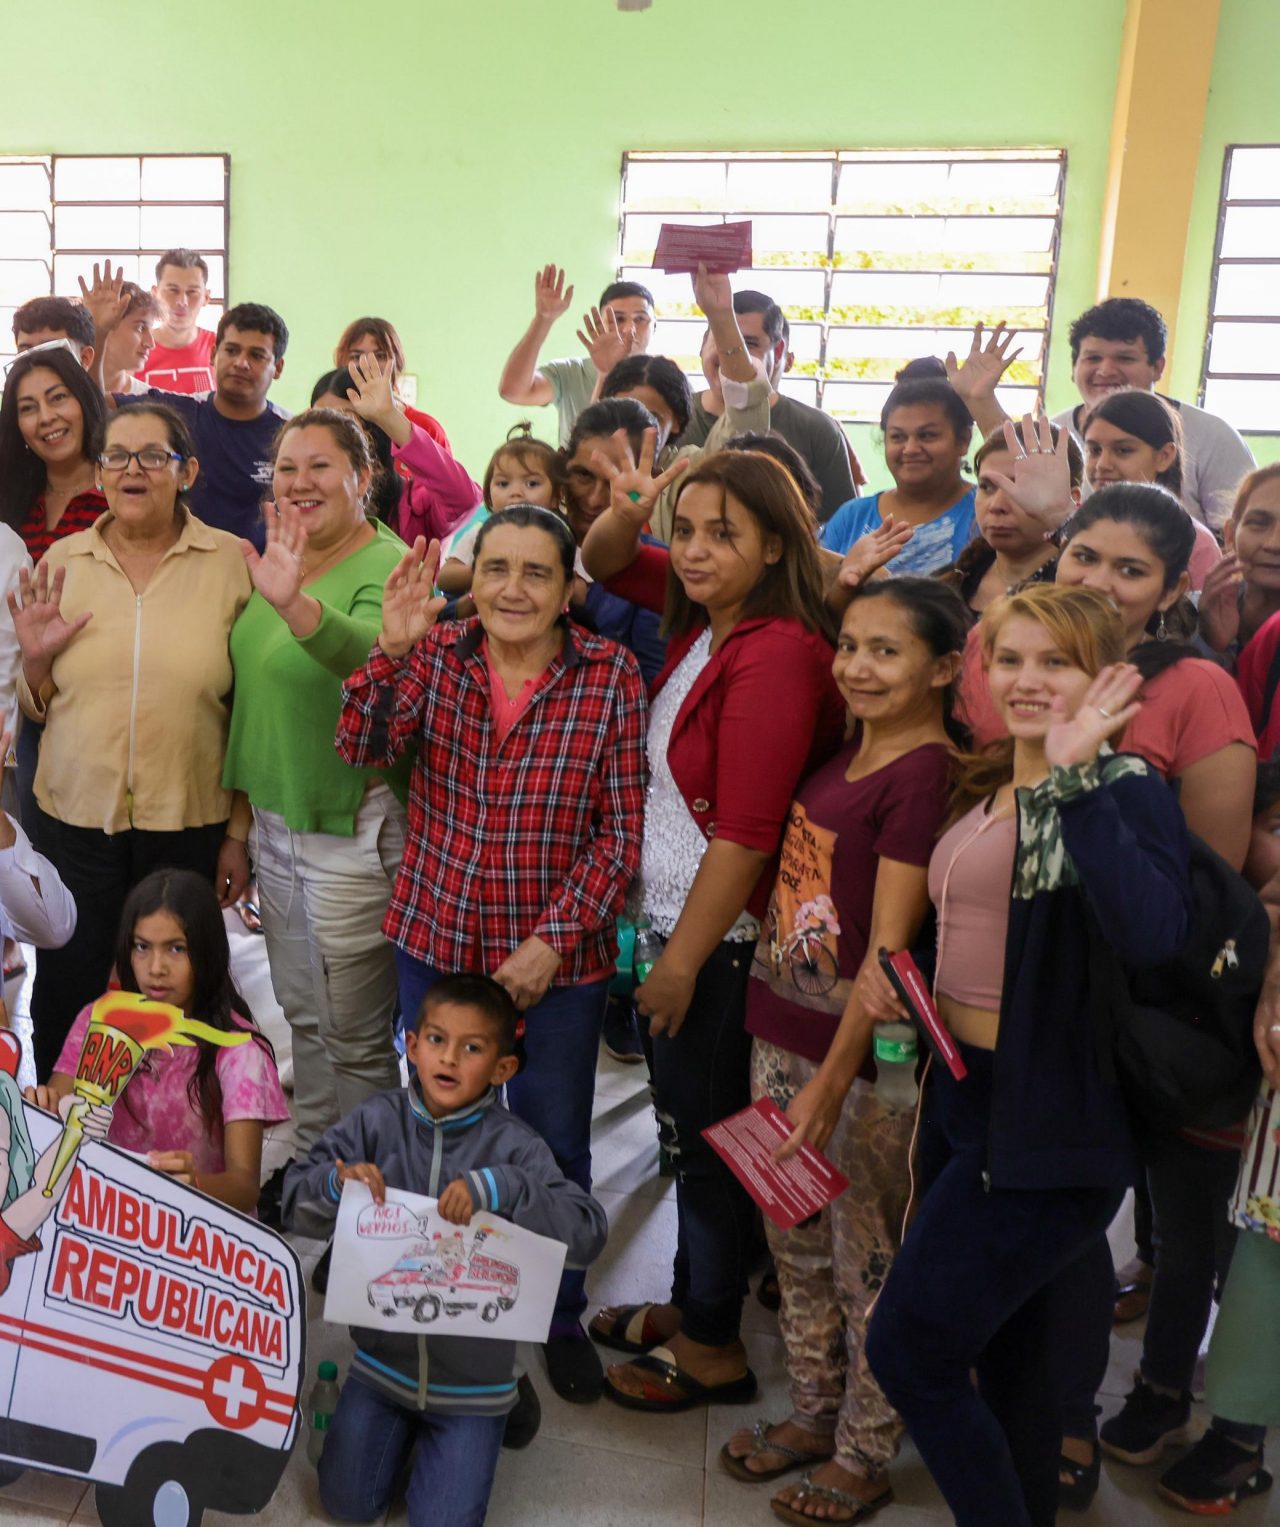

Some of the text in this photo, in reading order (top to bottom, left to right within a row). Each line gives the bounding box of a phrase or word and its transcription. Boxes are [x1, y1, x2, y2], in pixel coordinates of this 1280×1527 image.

[76, 1032, 133, 1096] ANR
[52, 1236, 283, 1361] REPUBLICANA
[62, 1166, 286, 1310] AMBULANCIA
